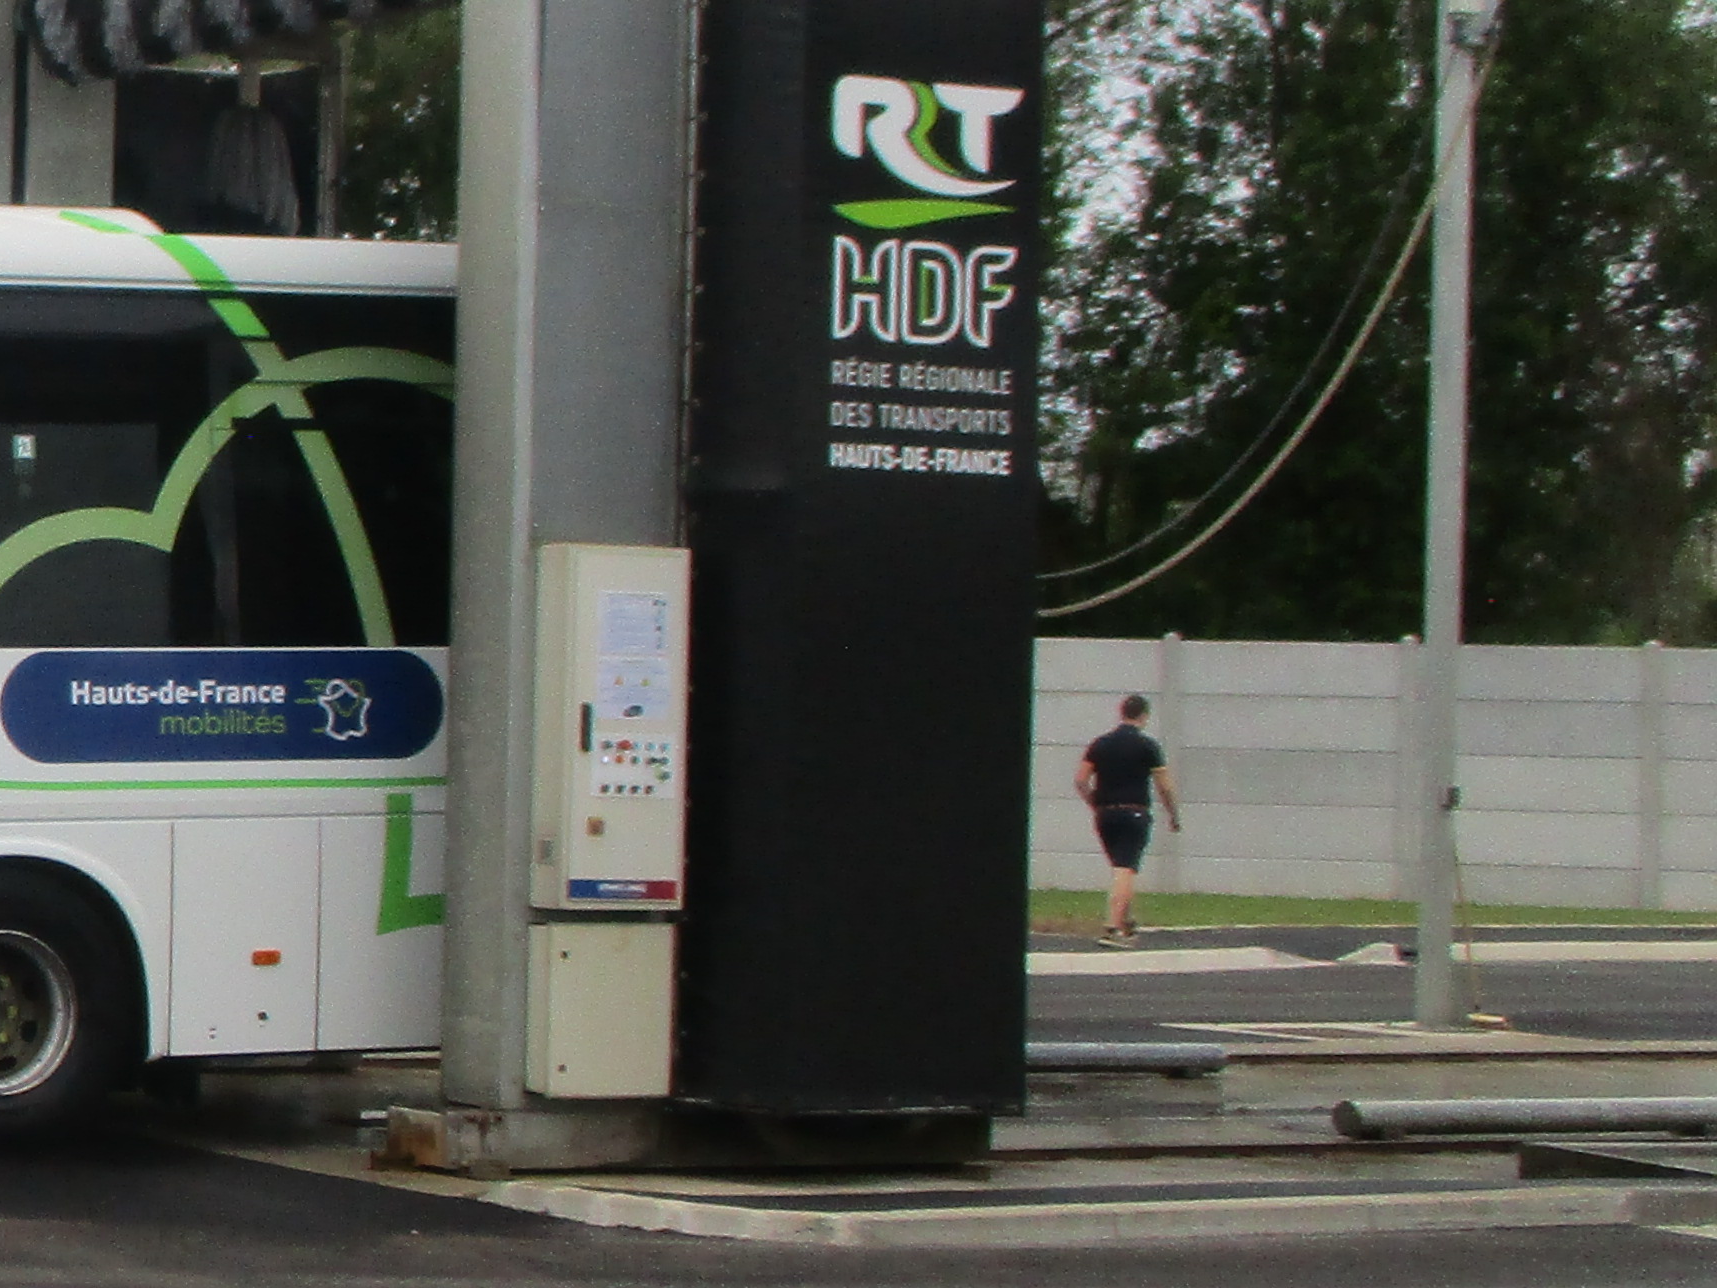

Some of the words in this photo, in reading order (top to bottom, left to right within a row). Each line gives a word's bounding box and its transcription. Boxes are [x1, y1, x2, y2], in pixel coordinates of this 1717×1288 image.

[830, 234, 1019, 349] HDF
[831, 357, 893, 389] RÉGIE
[898, 361, 1013, 395] RÉGIONALE
[830, 401, 873, 428] DES
[878, 403, 1012, 436] TRANSPORTS
[829, 442, 1013, 476] HAUTS-DE-FRANCE
[70, 679, 287, 706] Hauts-de-France
[160, 709, 287, 735] mobilités
